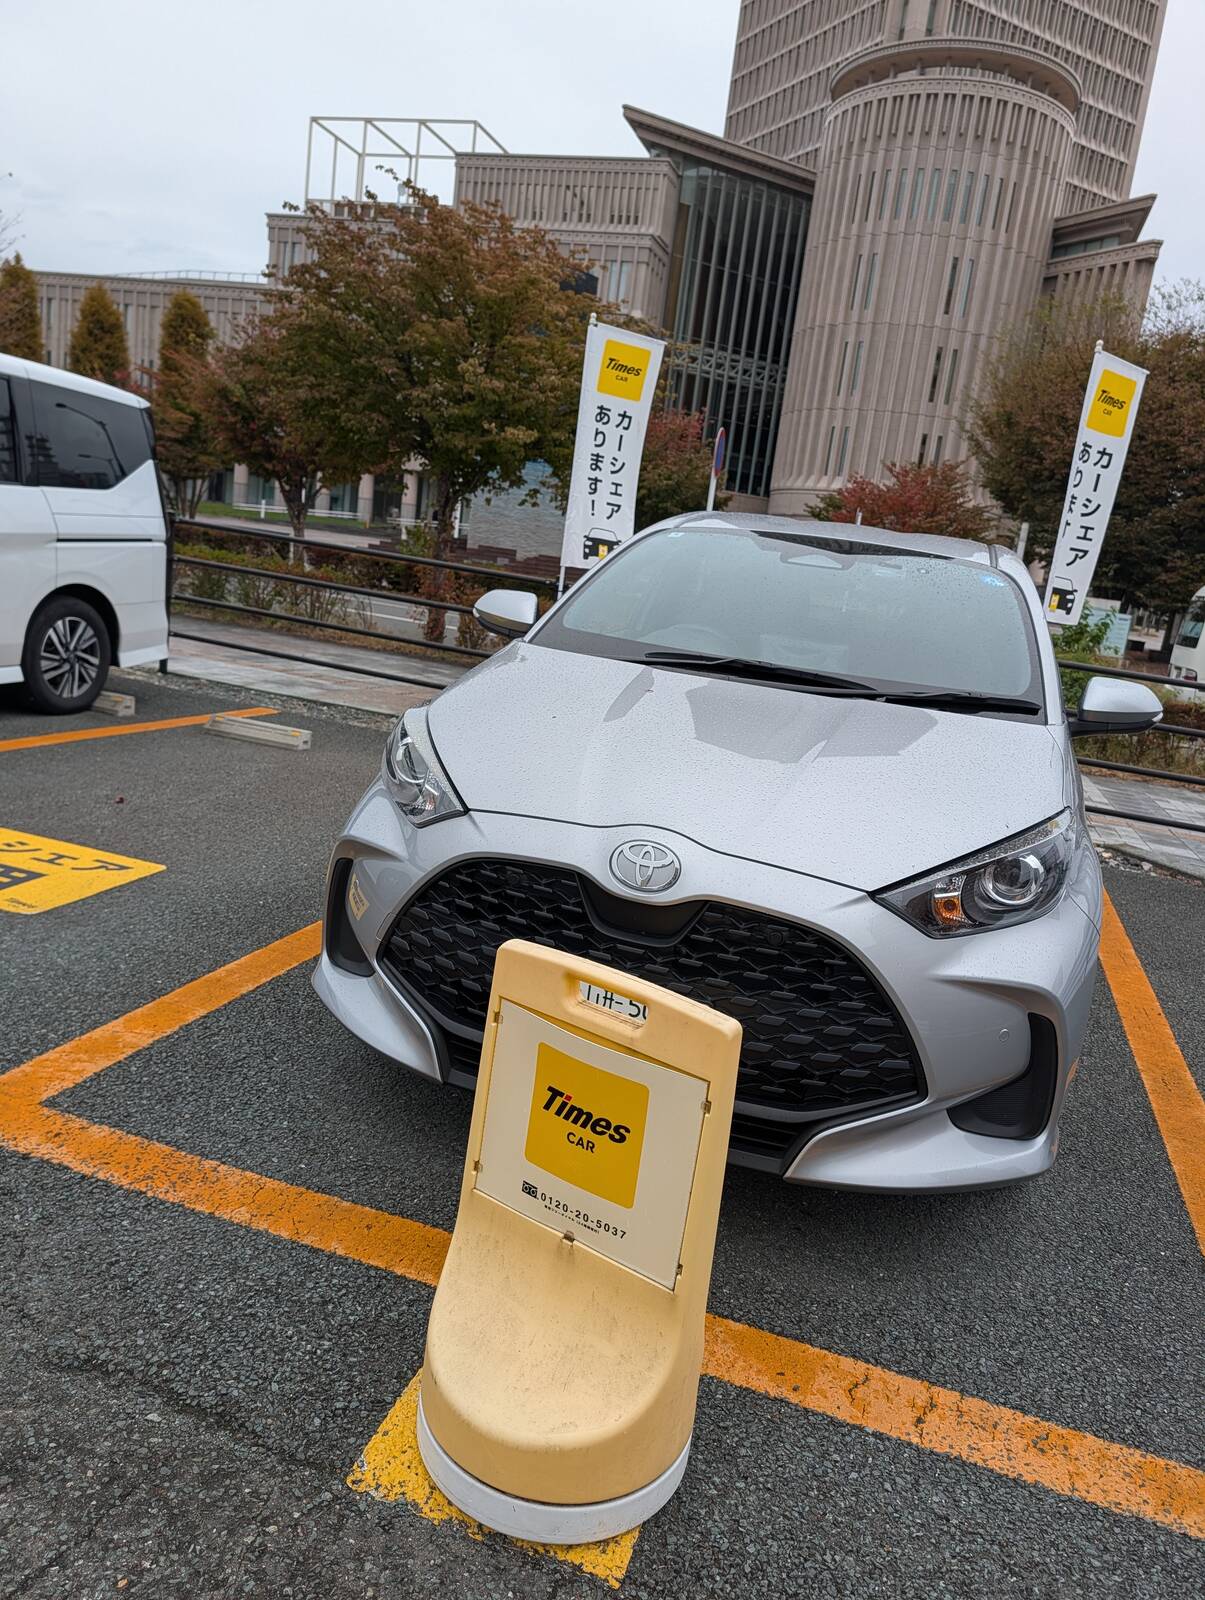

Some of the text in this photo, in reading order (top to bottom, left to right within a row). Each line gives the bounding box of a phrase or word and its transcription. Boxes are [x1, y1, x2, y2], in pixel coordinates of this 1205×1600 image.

[606, 357, 642, 377] Times
[615, 374, 628, 383] CAR
[1097, 389, 1126, 410] Times
[587, 404, 612, 517] あります！
[605, 411, 633, 520] カーシェア
[1065, 447, 1114, 567] カーシェア
[542, 1085, 631, 1144] Times
[566, 1132, 596, 1154] CAR
[540, 1192, 627, 1240] 0120-20-5037
